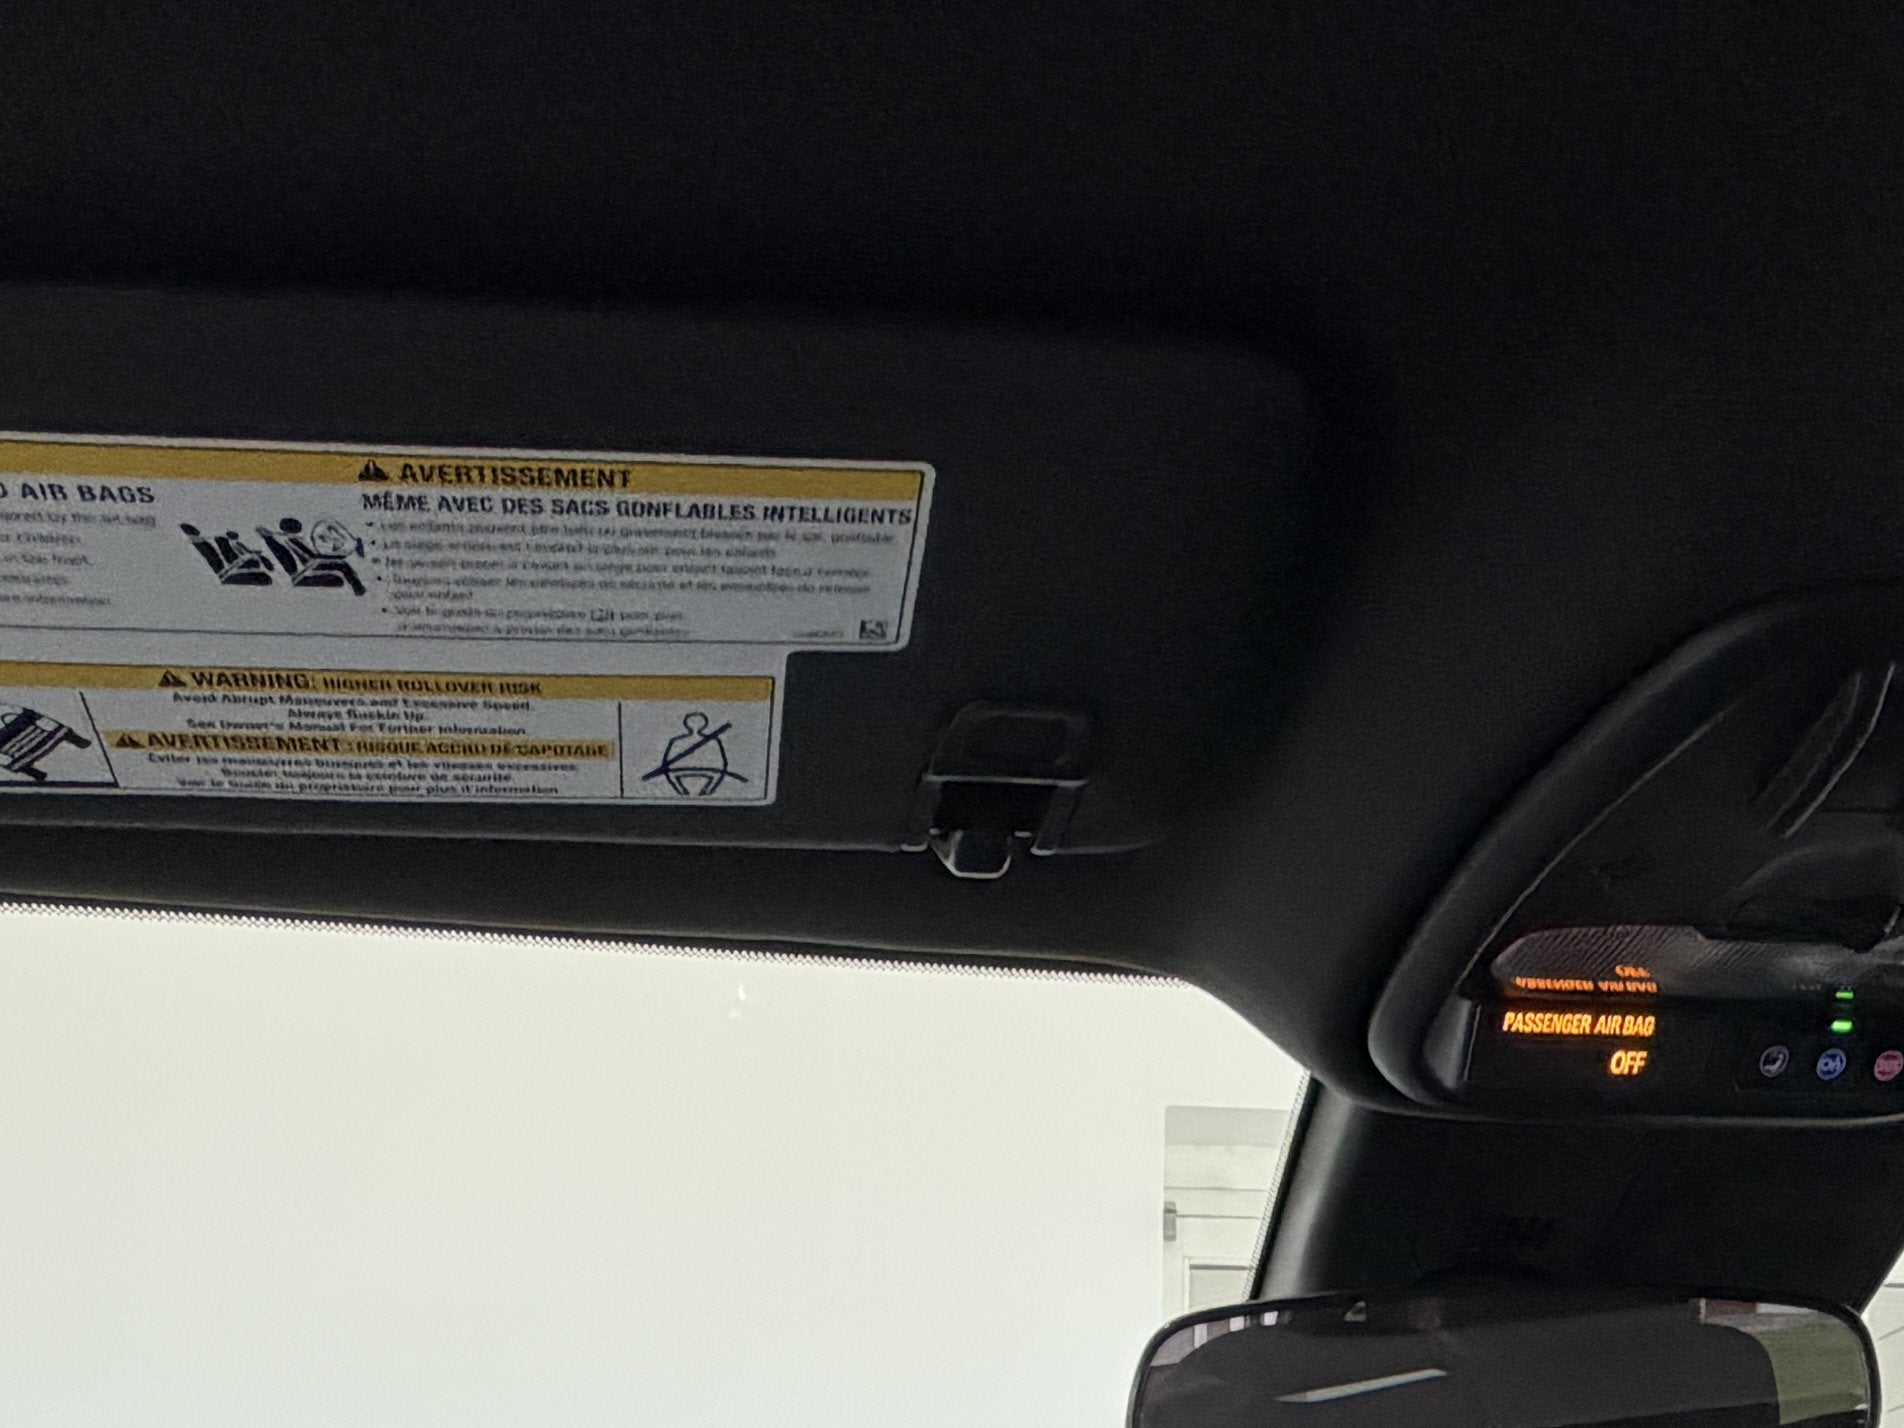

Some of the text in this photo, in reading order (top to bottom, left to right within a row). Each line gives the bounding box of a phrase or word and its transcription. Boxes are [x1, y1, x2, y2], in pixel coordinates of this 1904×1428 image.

[399, 463, 631, 488] AVERTISSEMENT
[21, 484, 67, 501] AIR
[77, 486, 155, 504] BAGS
[362, 490, 913, 526] MÊME AVEC DES SACS GONFLABLES INTELLIGENTS
[190, 671, 317, 690] WARNING:
[396, 679, 494, 694] ROLLOVER
[499, 682, 542, 695] RISK
[146, 732, 340, 754] AVERTISSEMENT
[1502, 1011, 1656, 1037] PASSENGER AIR BAG
[1610, 1050, 1648, 1075] OFF
